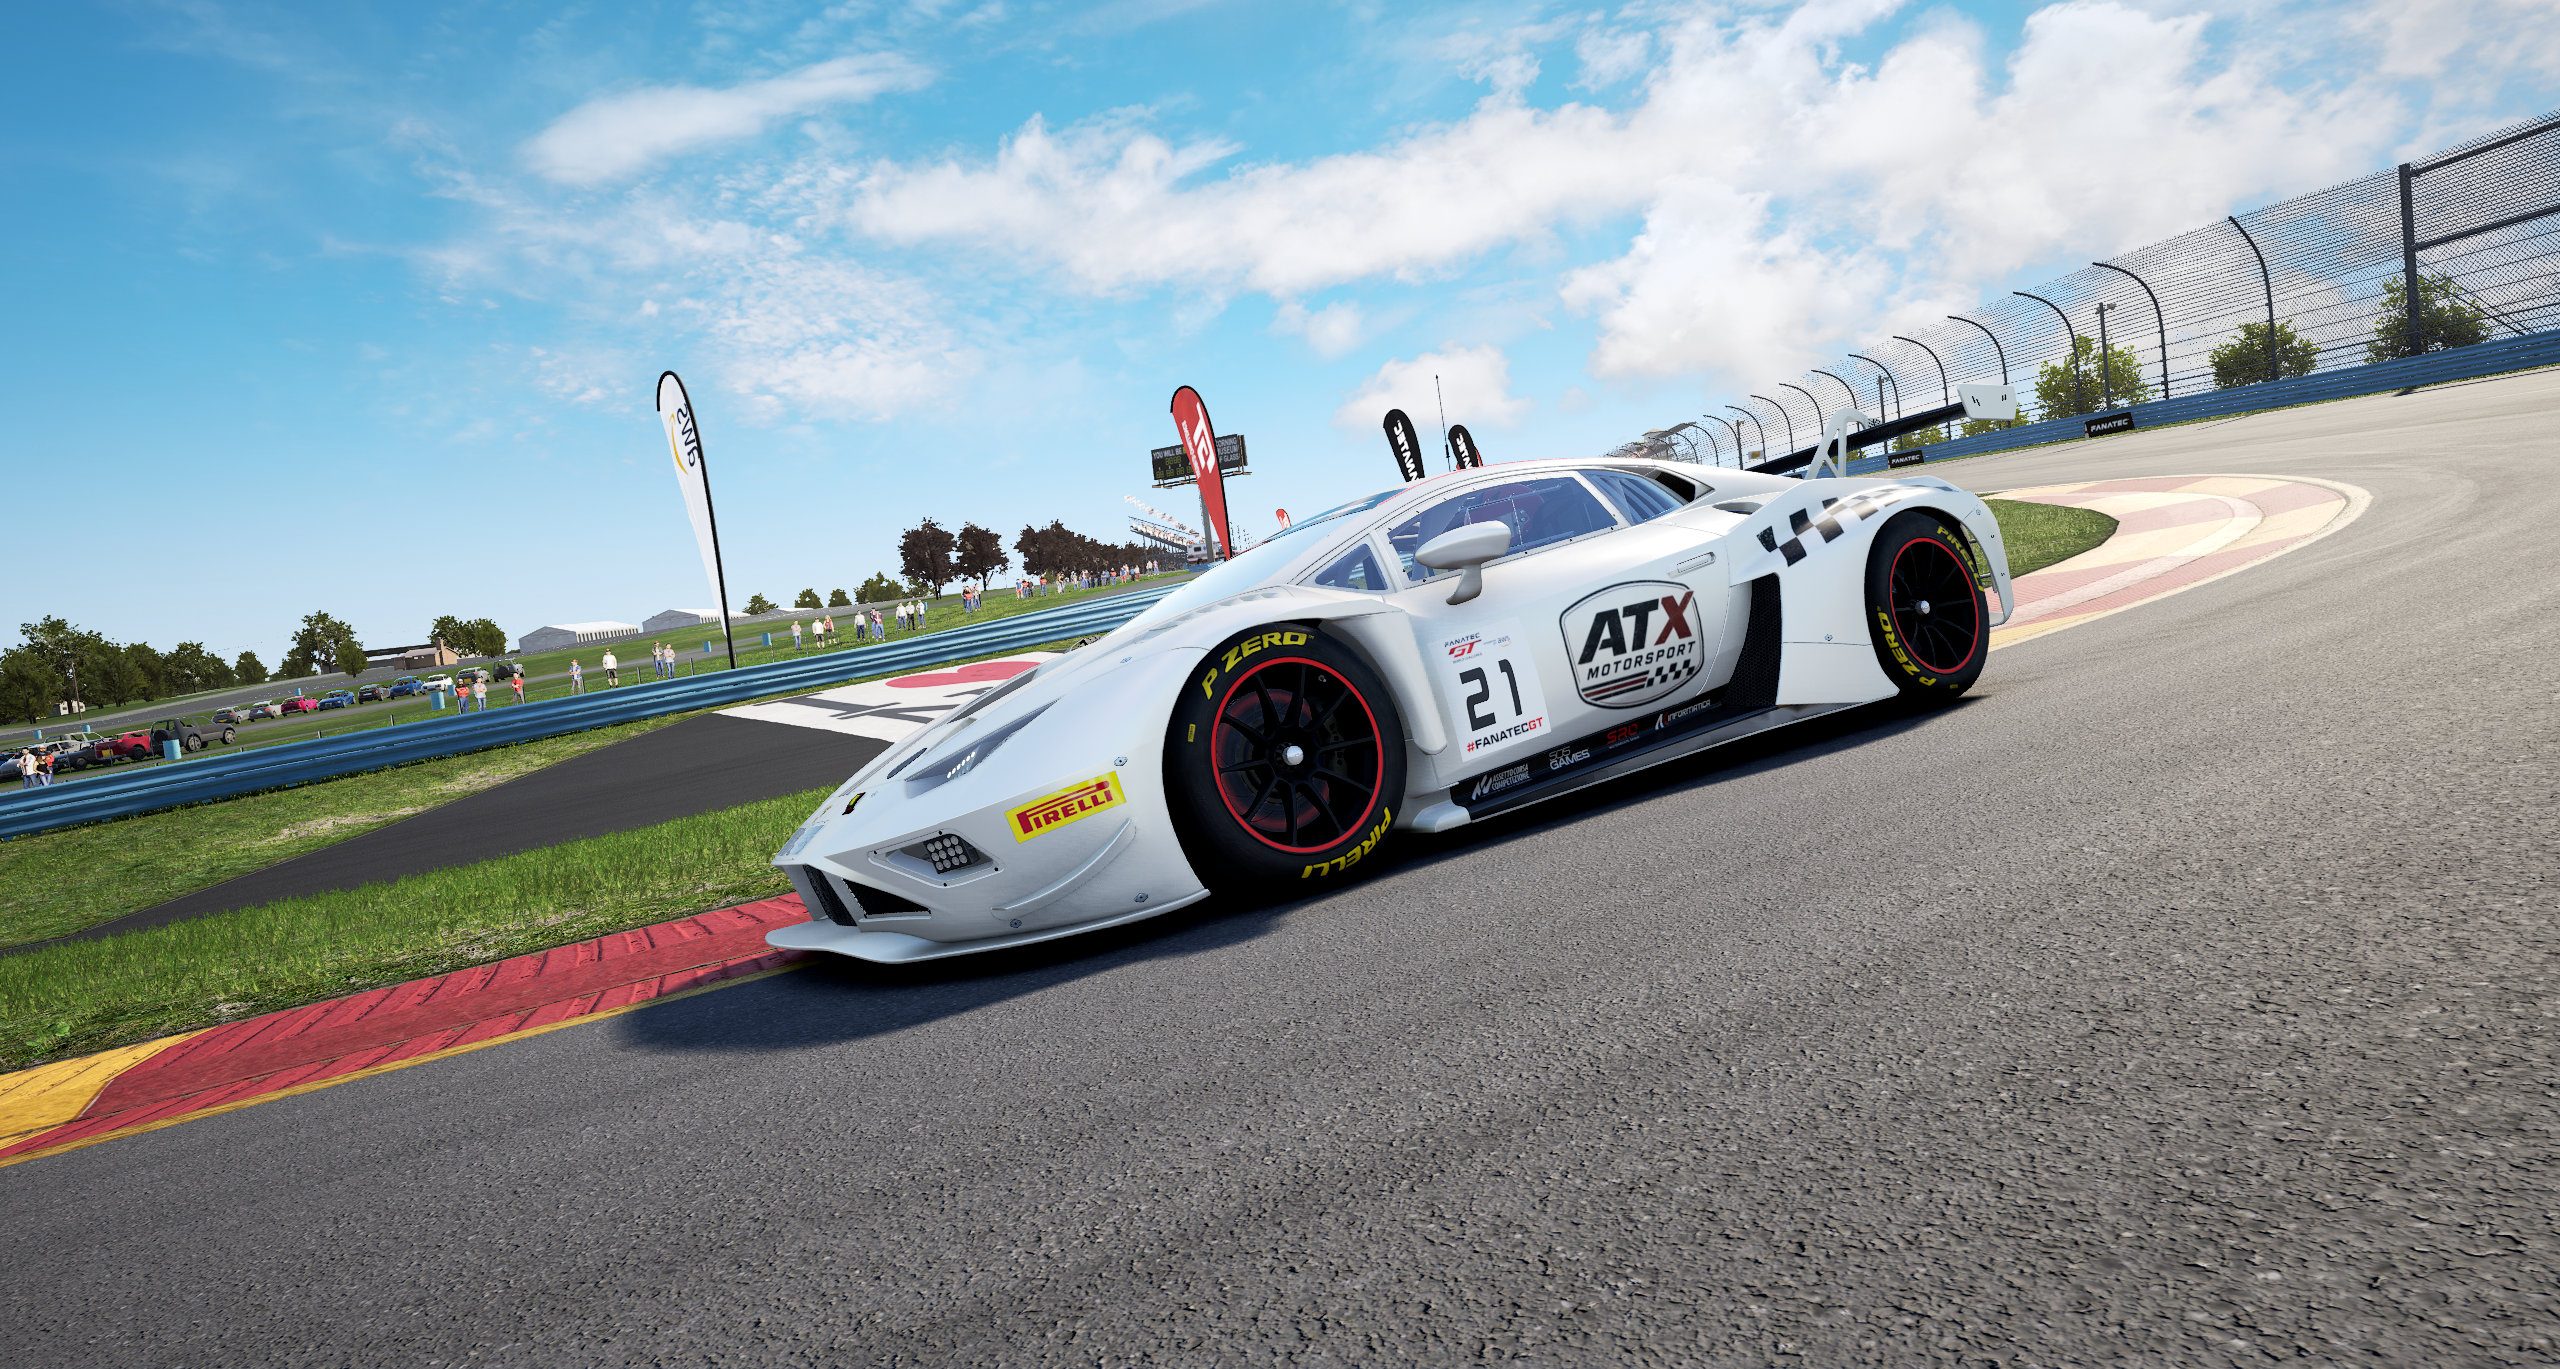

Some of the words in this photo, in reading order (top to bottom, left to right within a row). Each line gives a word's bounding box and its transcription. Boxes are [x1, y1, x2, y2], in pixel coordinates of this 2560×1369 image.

[2091, 419, 2129, 432] FANATEC
[1153, 449, 1163, 459] YOU
[1163, 448, 1175, 458] WILL
[1892, 455, 1920, 464] FANATEC
[1937, 525, 1985, 592] PIRELLI
[1444, 632, 1480, 647] FANATEC
[1578, 591, 1694, 665] ATX
[1448, 639, 1482, 658] GT
[1587, 641, 1696, 680] MOTORSPORT
[1201, 667, 1218, 700] P
[1918, 676, 1937, 687] P
[1459, 659, 1522, 732] 21
[1467, 717, 1543, 752] #FANATECGT
[1607, 723, 1638, 745] SRO
[1550, 750, 1590, 771] GAMES
[1016, 780, 1114, 835] PIRELLI
[1301, 806, 1392, 879] PIRELLI
